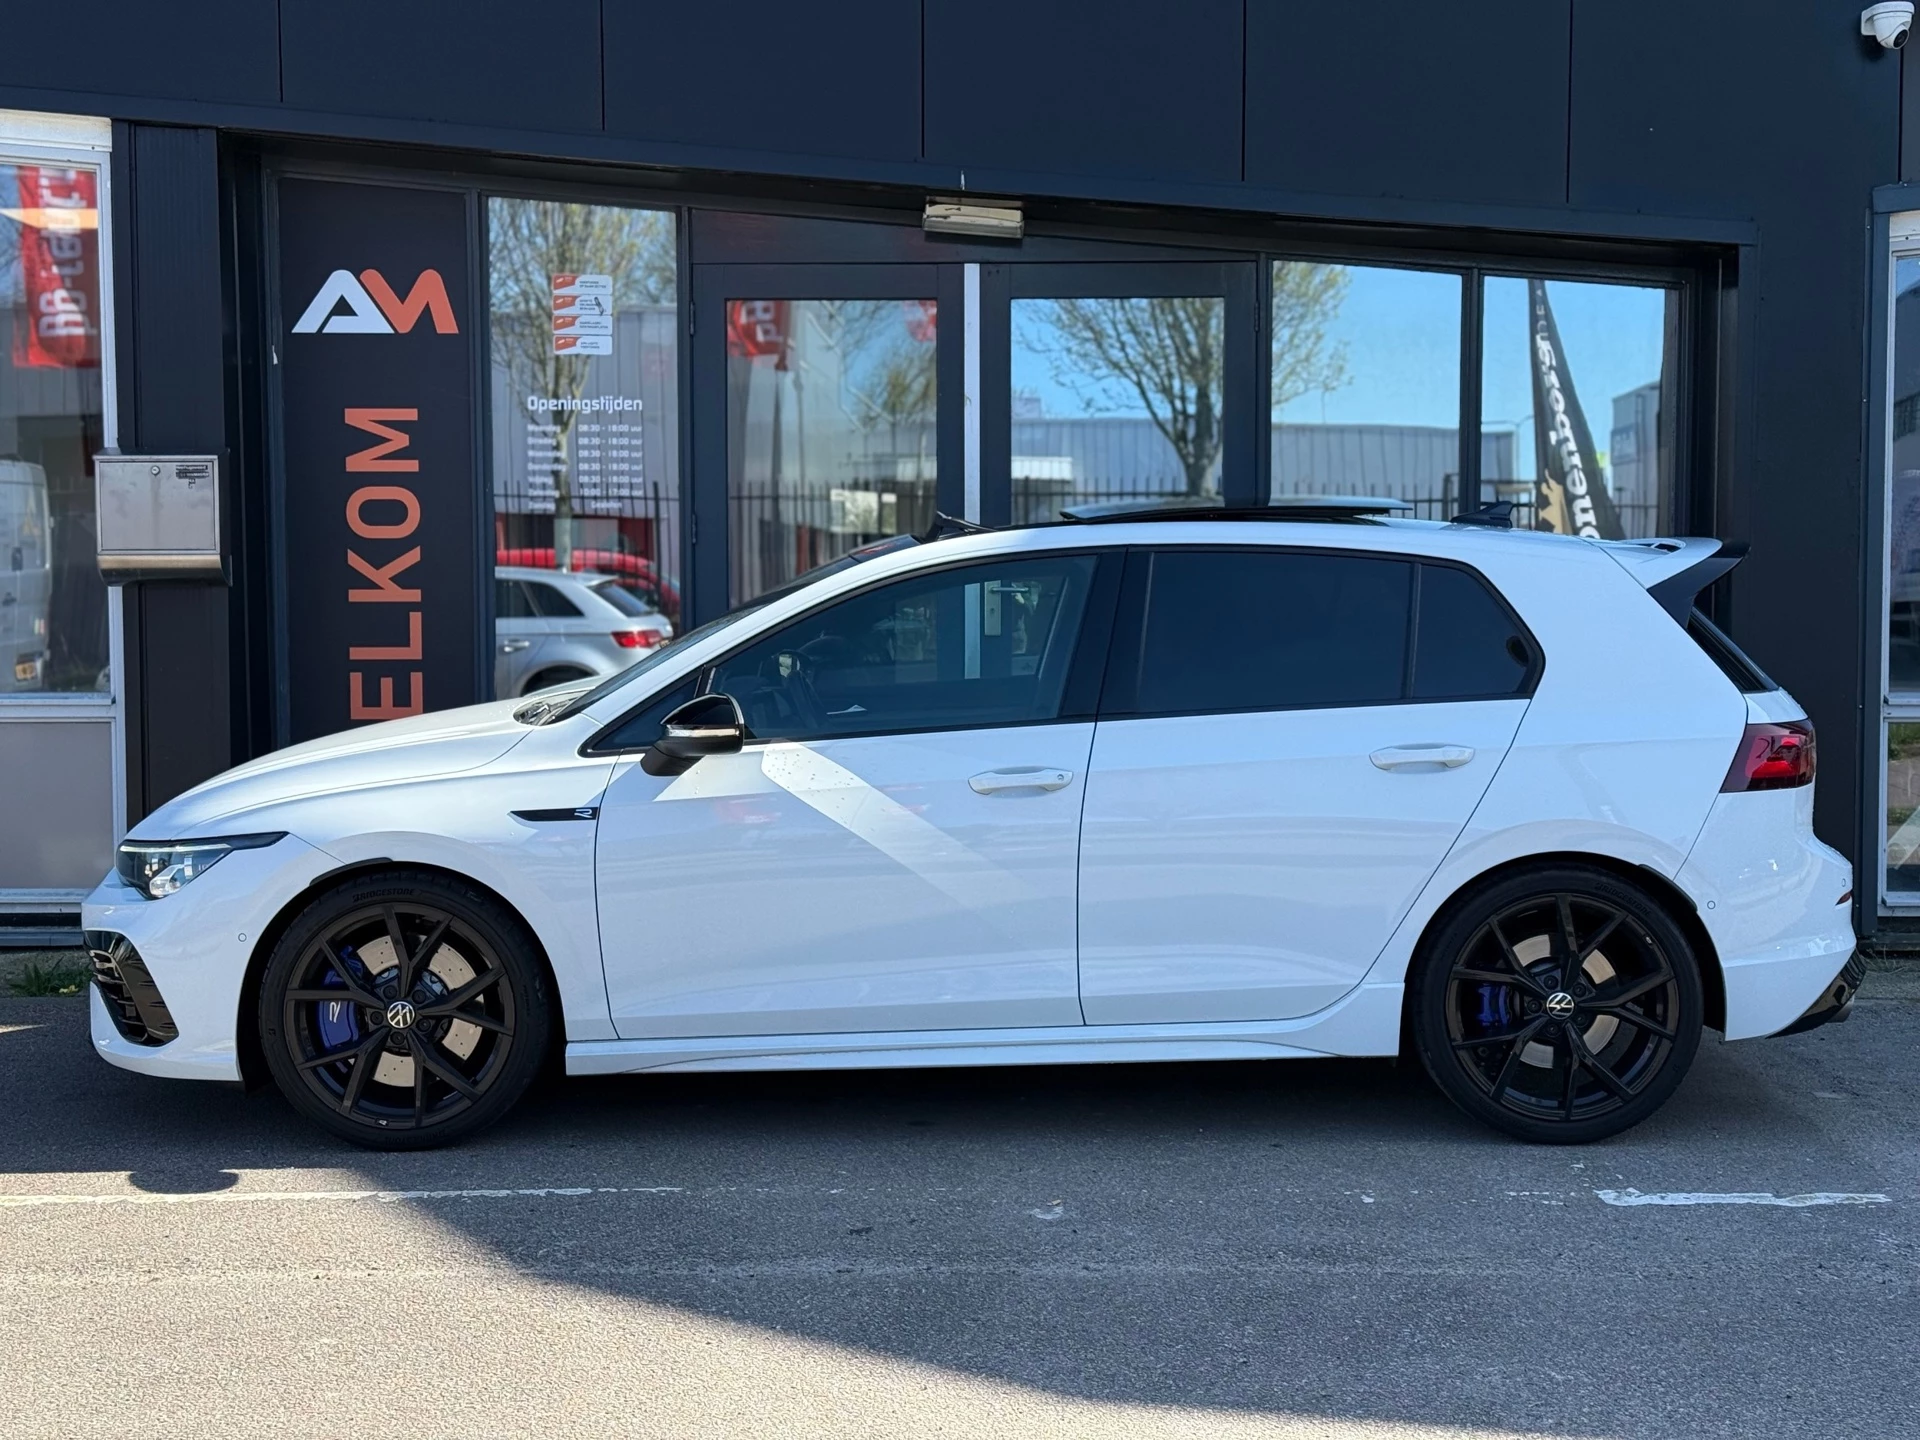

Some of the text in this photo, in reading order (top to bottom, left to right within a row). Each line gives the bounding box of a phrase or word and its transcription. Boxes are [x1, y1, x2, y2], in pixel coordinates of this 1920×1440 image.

[291, 269, 459, 334] AM
[527, 396, 643, 414] Openingstijden
[345, 408, 424, 720] ELKOM
